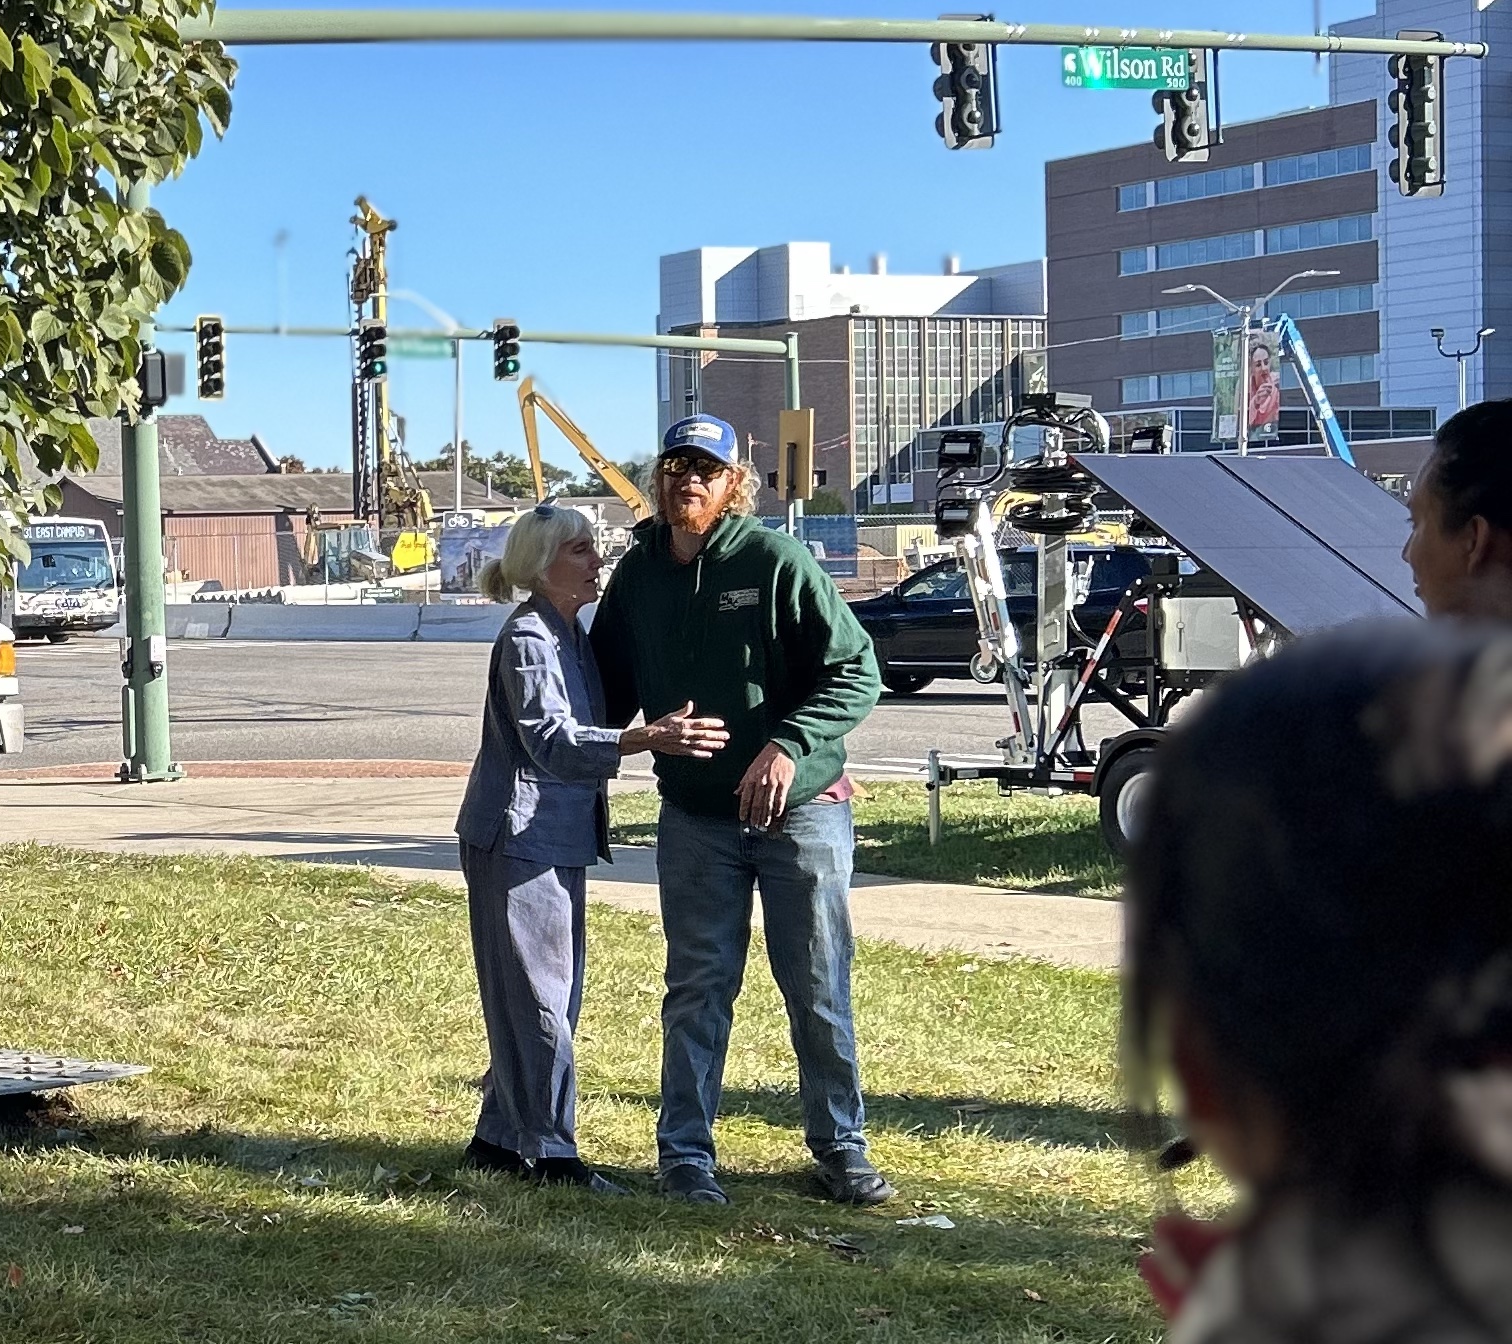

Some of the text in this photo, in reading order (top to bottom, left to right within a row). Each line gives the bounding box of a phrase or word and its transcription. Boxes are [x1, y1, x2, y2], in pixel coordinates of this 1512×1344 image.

[1079, 47, 1186, 80] Wilson Rd
[1064, 76, 1186, 88] 400 500
[23, 526, 32, 539] 31
[35, 526, 55, 539] EAST
[55, 525, 86, 538] CAMPUS
